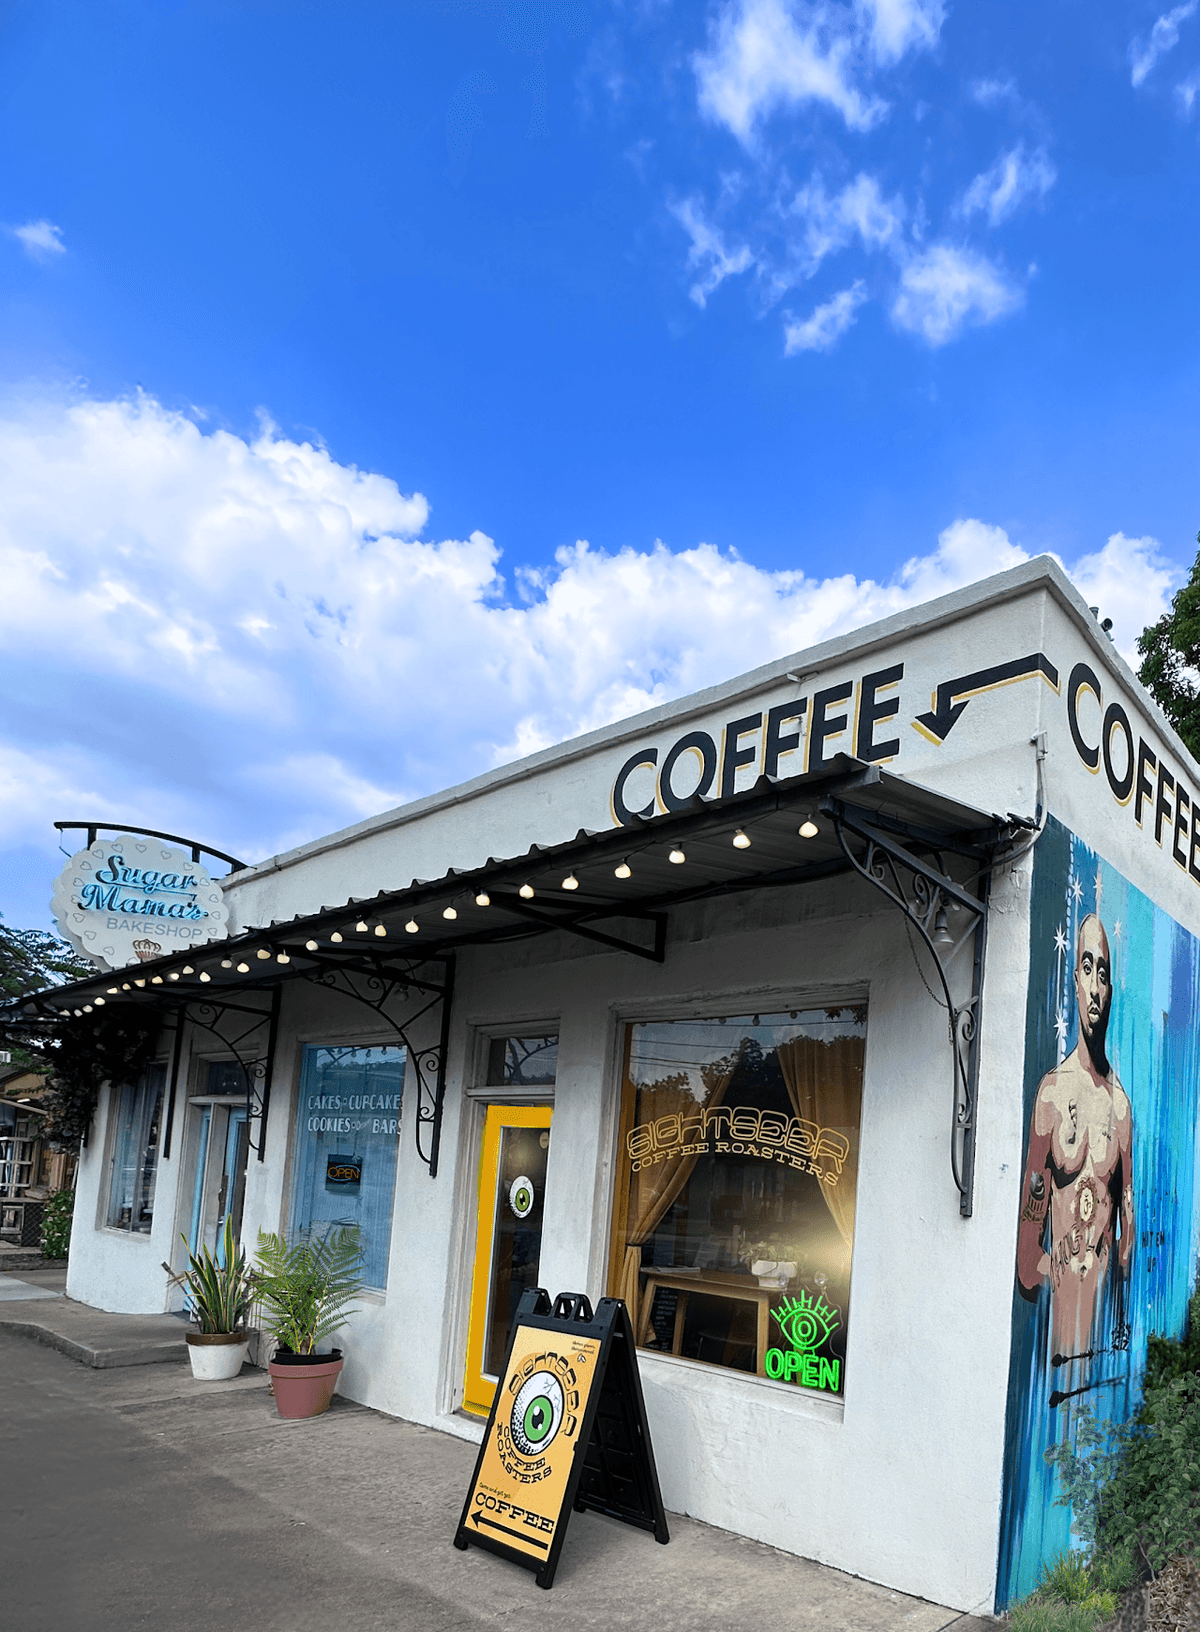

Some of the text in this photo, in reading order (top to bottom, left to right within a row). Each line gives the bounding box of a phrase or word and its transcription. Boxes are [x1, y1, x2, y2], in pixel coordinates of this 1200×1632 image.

[610, 662, 904, 827] COFFEE
[1067, 662, 1200, 886] COFFEE
[96, 855, 198, 893] Sugar
[107, 918, 203, 939] BAKESHOP
[308, 1094, 403, 1109] CAKES CUPCAKE
[308, 1117, 350, 1132] COOKIES
[328, 1167, 359, 1178] OPEN
[631, 1142, 839, 1186] COFFEE ROASTERS
[765, 1348, 840, 1392] OPEN
[497, 1422, 552, 1484] ROASTERS
[504, 1426, 545, 1471] COFFEE
[475, 1492, 555, 1534] COFFEE
